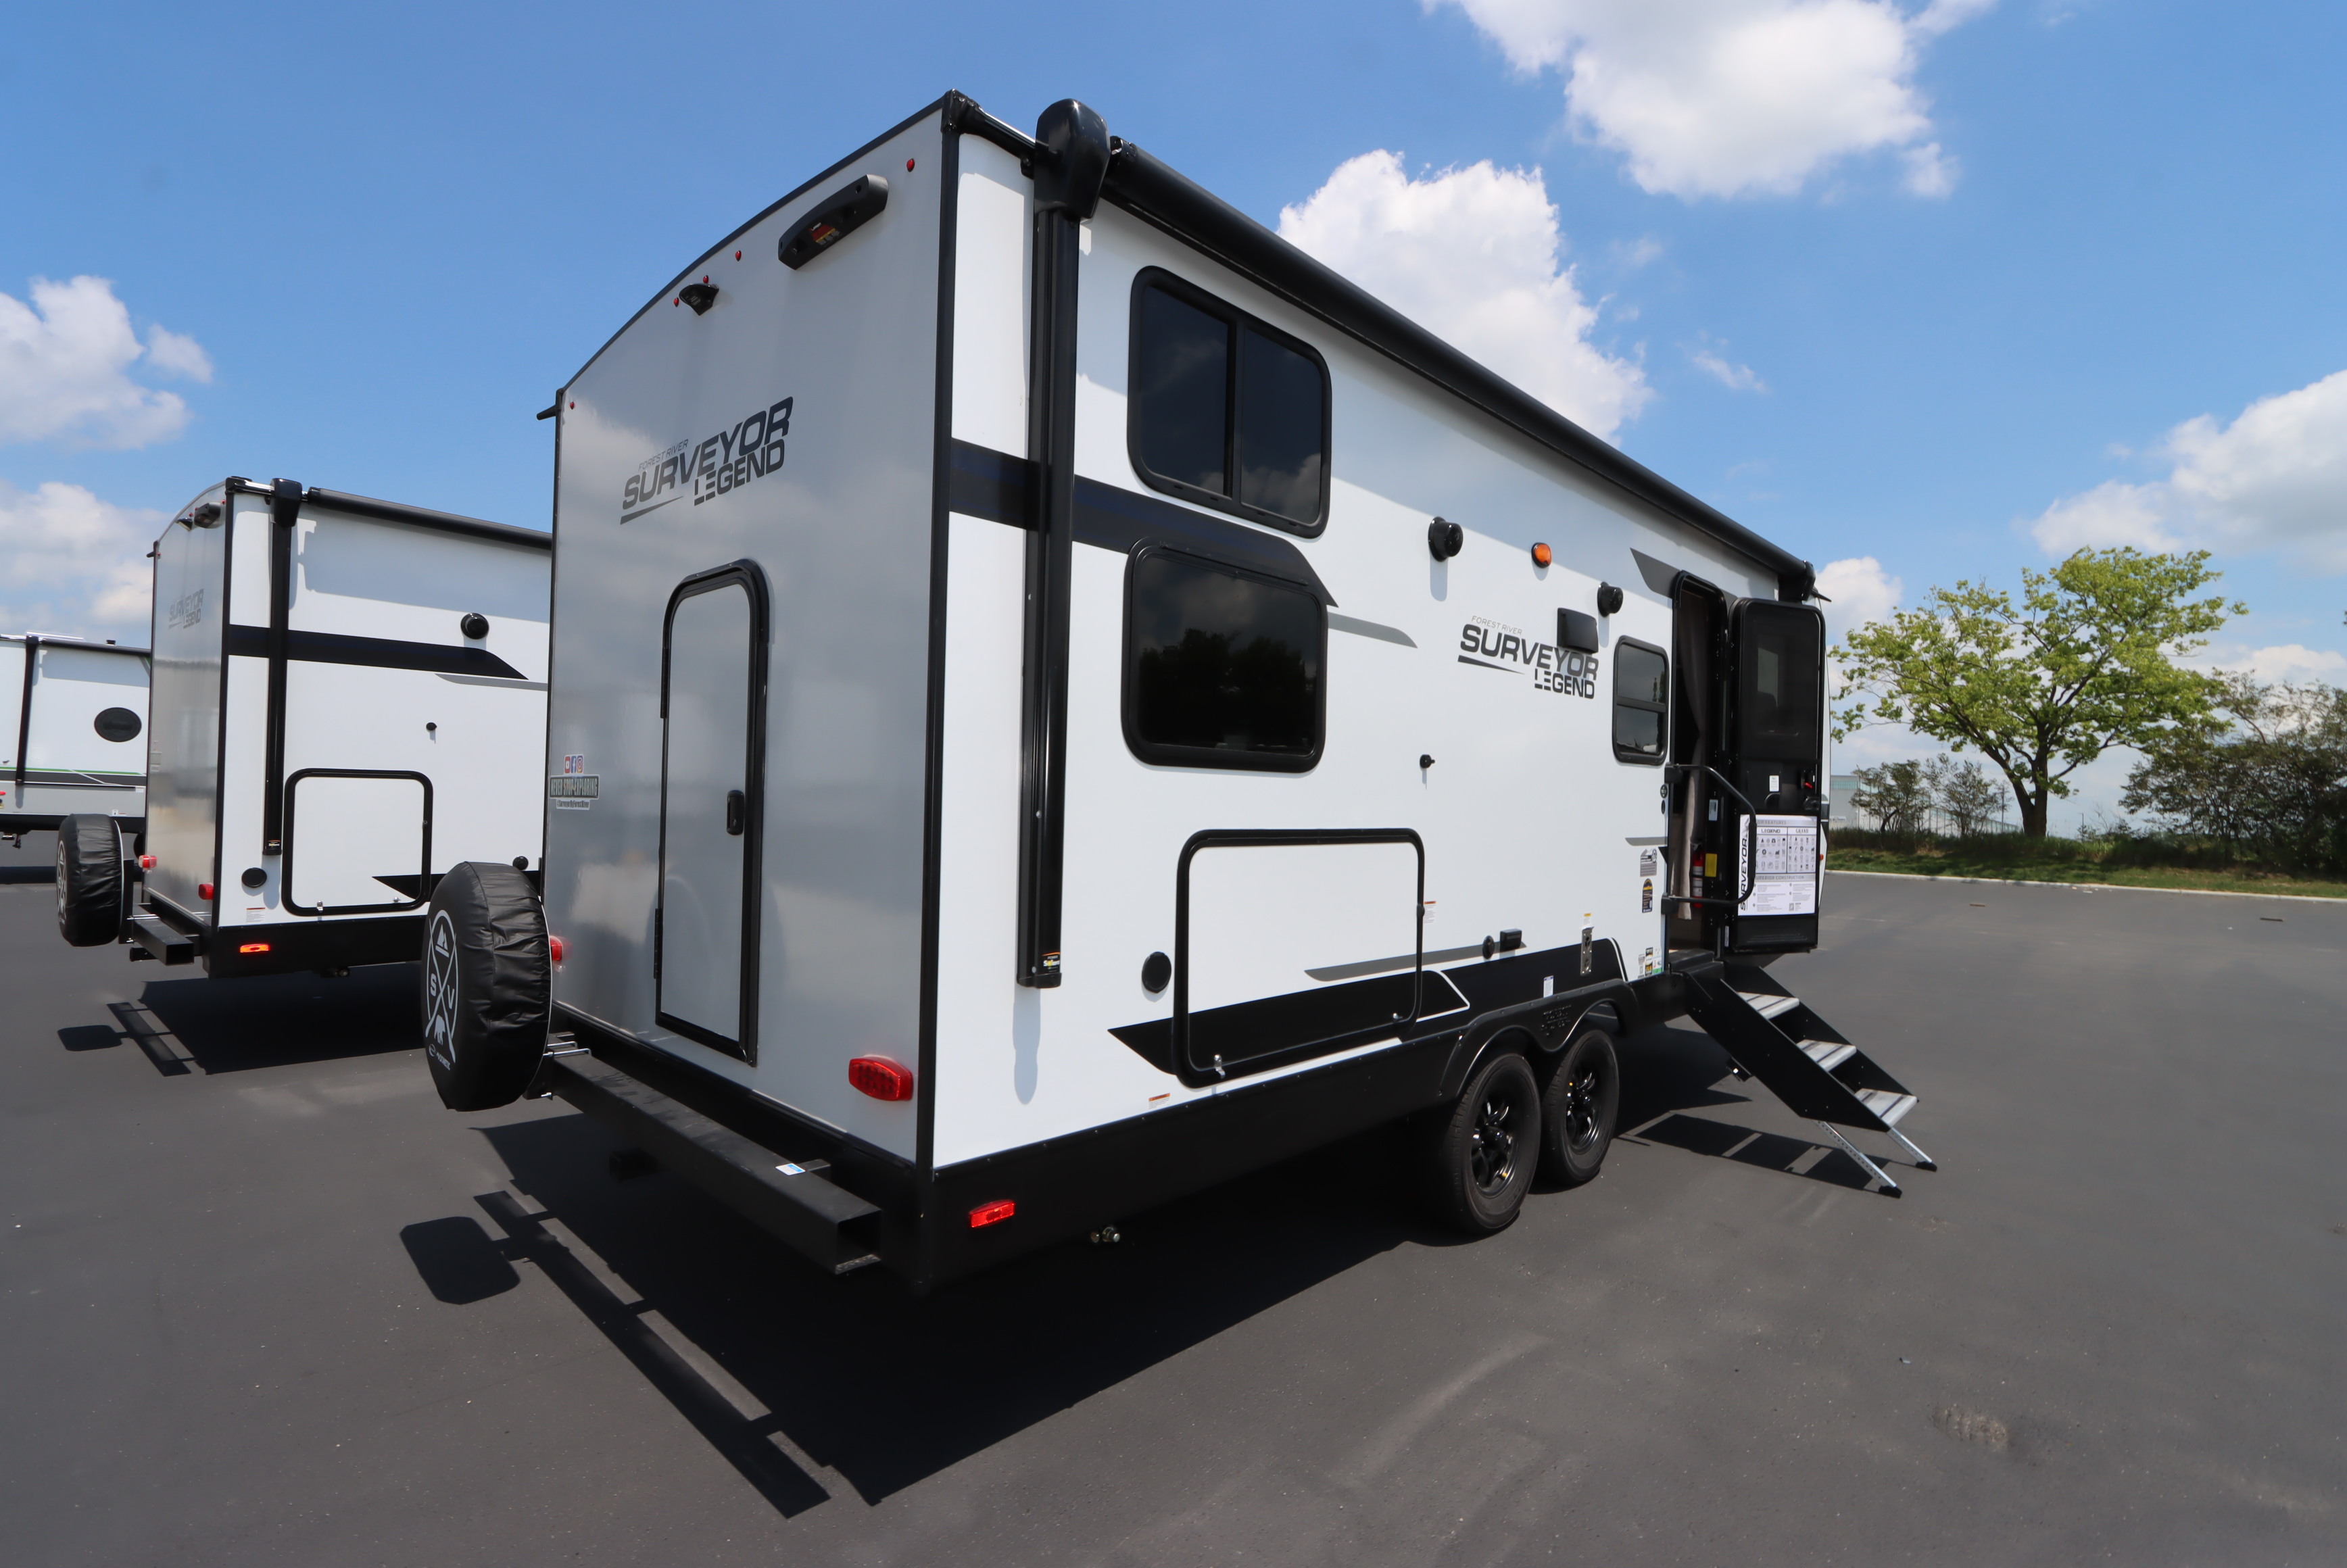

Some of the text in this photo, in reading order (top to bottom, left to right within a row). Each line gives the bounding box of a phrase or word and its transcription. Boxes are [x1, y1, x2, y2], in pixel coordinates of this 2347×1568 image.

[623, 396, 794, 510] SURVEYOR
[638, 439, 689, 472] FOREST RIVER
[694, 439, 785, 506] LEGEND
[169, 588, 204, 622] SURVEYOR
[1471, 615, 1522, 636] FOREST RIVER
[1460, 623, 1599, 681] SURVEYOR
[1534, 668, 1595, 700] LEGEND
[551, 778, 563, 795] NEVER
[430, 973, 455, 1010] S V
